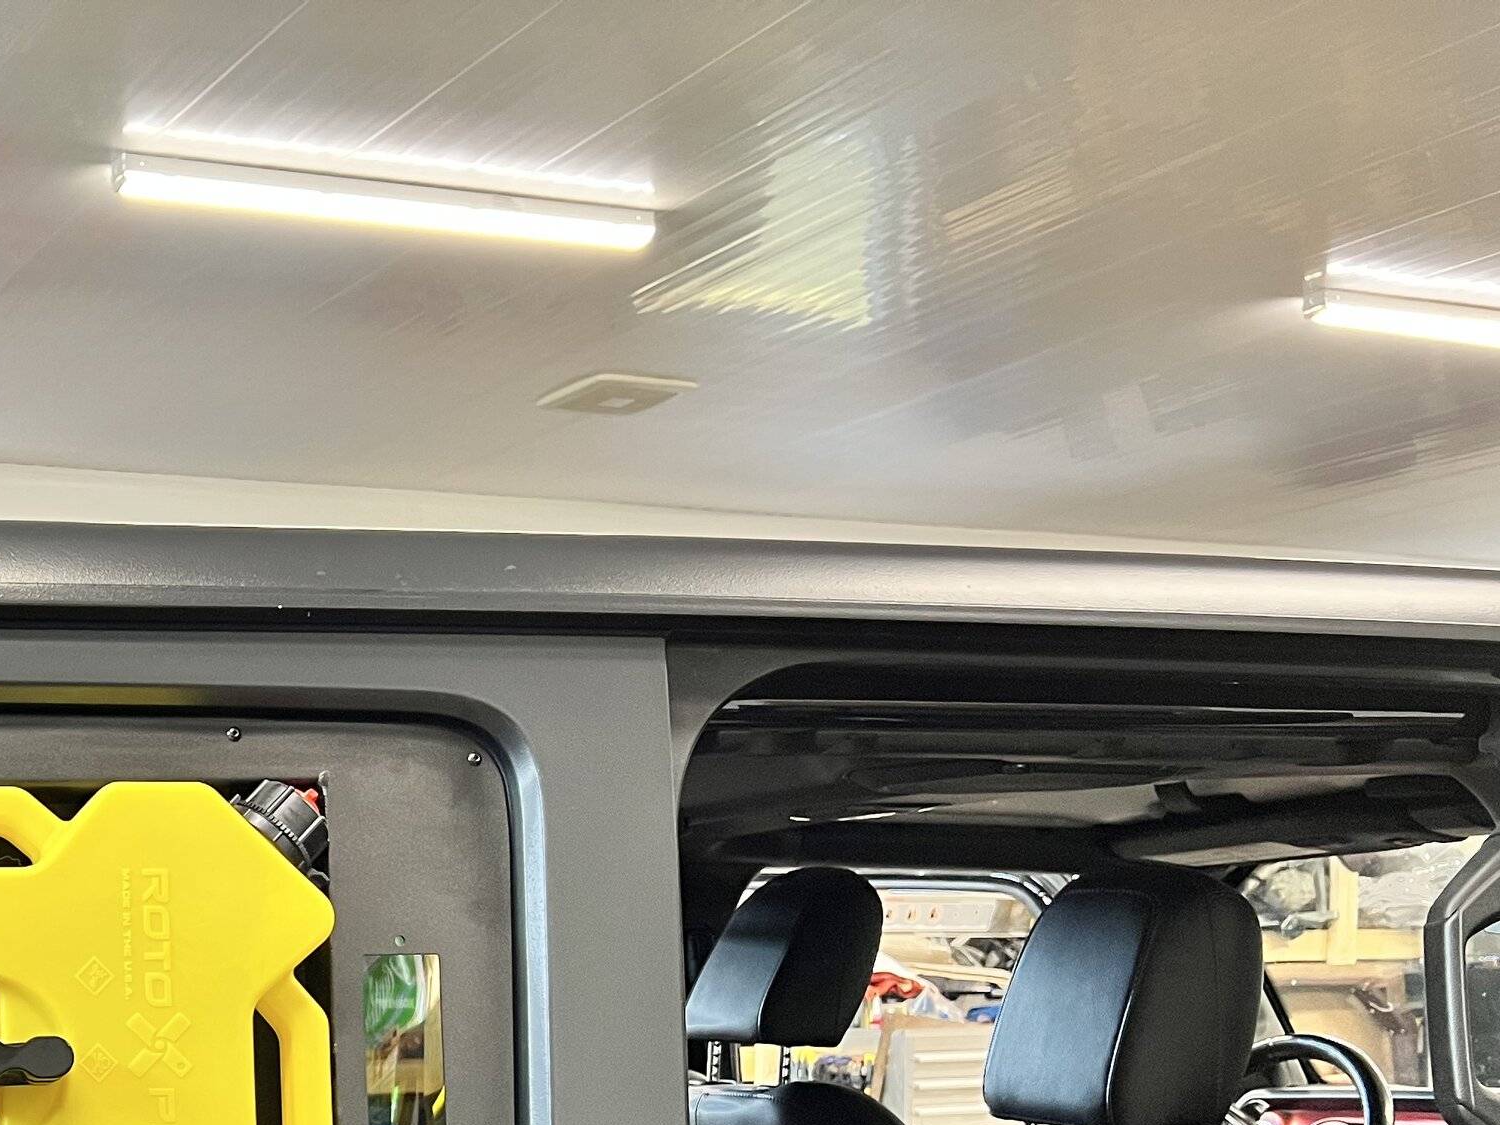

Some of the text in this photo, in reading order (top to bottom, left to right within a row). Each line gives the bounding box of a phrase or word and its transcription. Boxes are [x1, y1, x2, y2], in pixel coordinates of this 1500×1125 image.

[121, 867, 133, 1000] MADE IN THE U.S.A.
[140, 866, 173, 1009] ROTO
